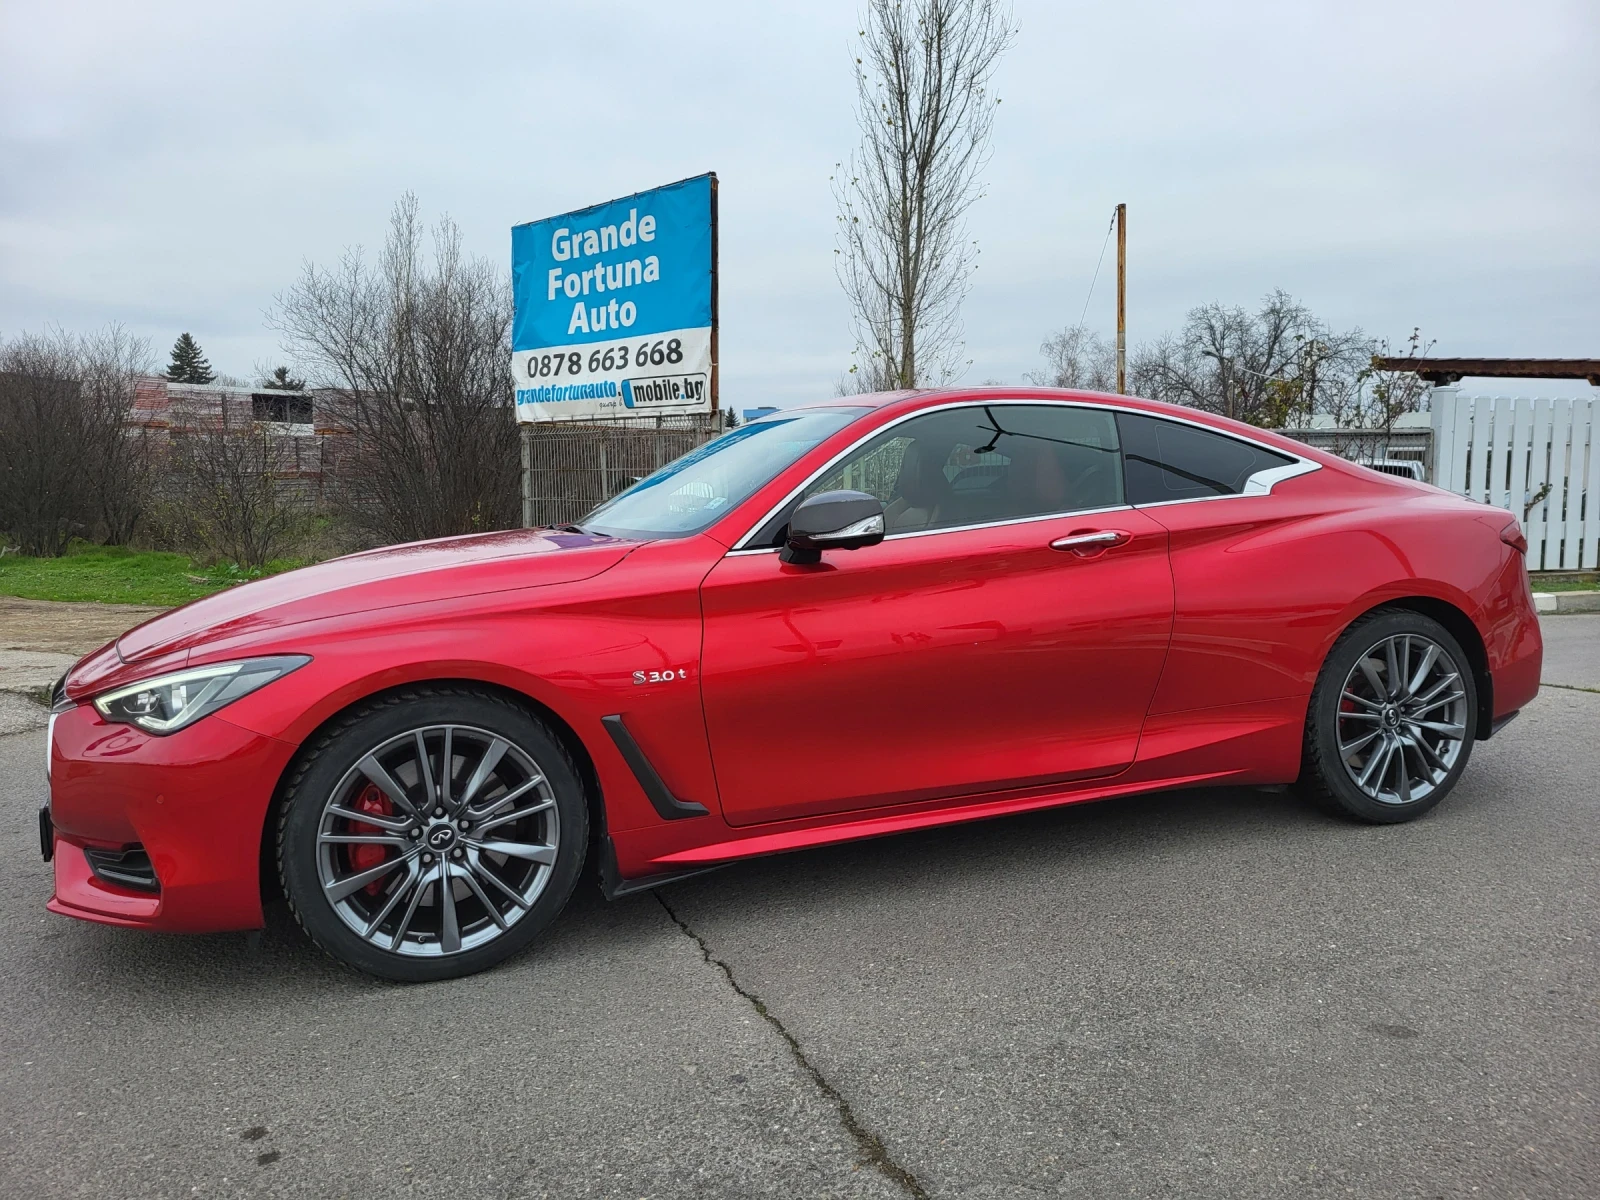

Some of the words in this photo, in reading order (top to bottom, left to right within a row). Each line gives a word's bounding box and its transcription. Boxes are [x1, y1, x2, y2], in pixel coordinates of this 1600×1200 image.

[551, 208, 656, 262] Grande
[547, 255, 660, 301] Fortuna
[567, 298, 637, 335] Auto
[527, 352, 582, 378] 0878
[588, 346, 629, 373] 663
[635, 338, 683, 368] 668
[633, 378, 704, 402] mobile.bg
[632, 670, 646, 684] S
[649, 670, 675, 682] 3.0
